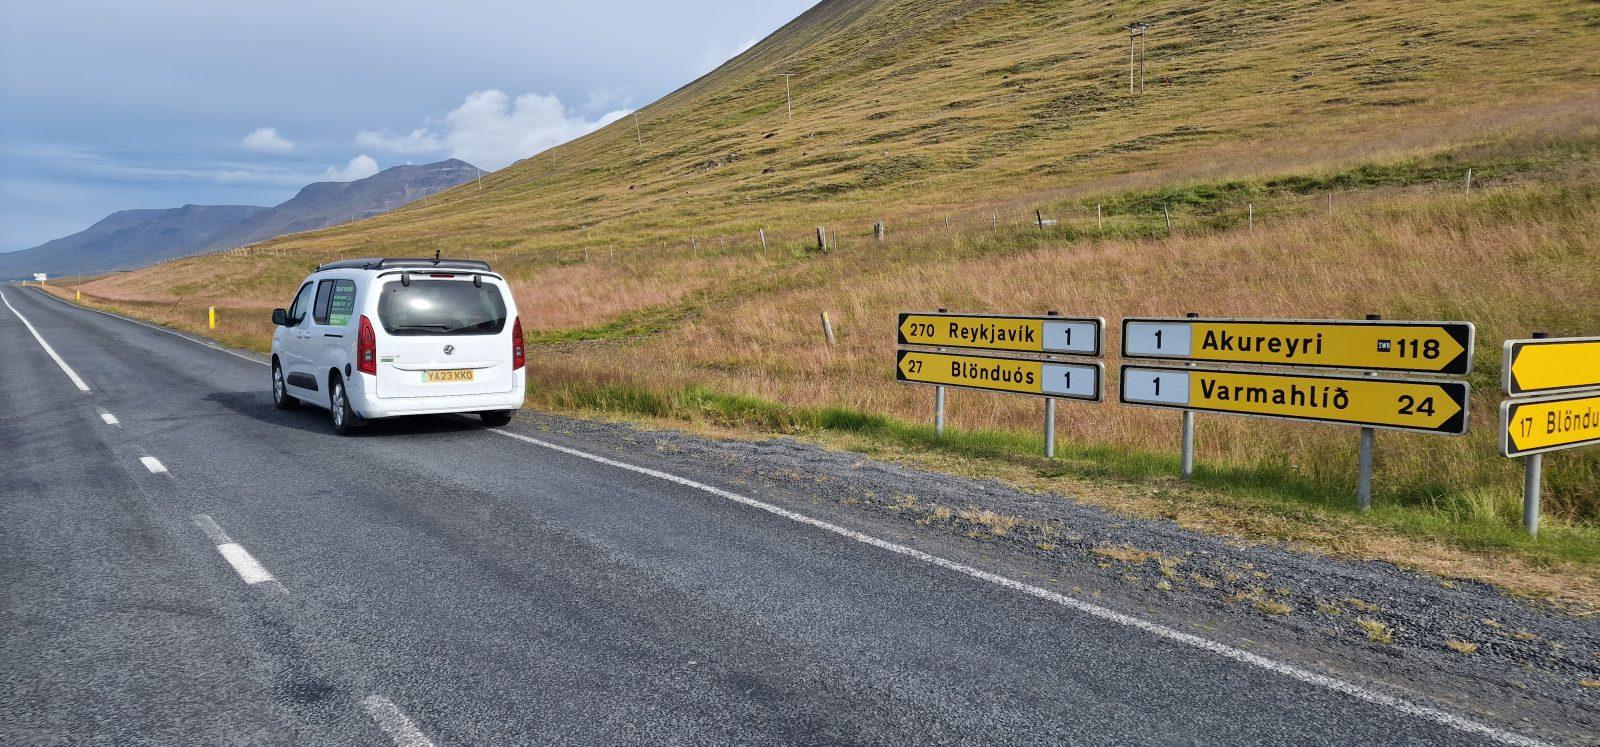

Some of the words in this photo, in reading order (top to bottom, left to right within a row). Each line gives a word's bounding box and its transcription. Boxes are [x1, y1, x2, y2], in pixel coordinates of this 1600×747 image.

[910, 323, 935, 338] 270
[949, 322, 1035, 343] Reykjavík
[1064, 327, 1071, 345] 1
[1154, 330, 1162, 349] 1
[1202, 330, 1323, 358] Akureyri
[1397, 338, 1440, 360] 118
[428, 372, 453, 380] YA23
[908, 359, 923, 374] 27
[951, 361, 1034, 385] Blönduós
[1064, 371, 1071, 389] 1
[1152, 377, 1160, 396] 1
[1200, 379, 1349, 410] Varmahlíð
[1398, 395, 1436, 417] 24
[1520, 417, 1533, 438] 17
[1546, 406, 1600, 435] Blöndu
